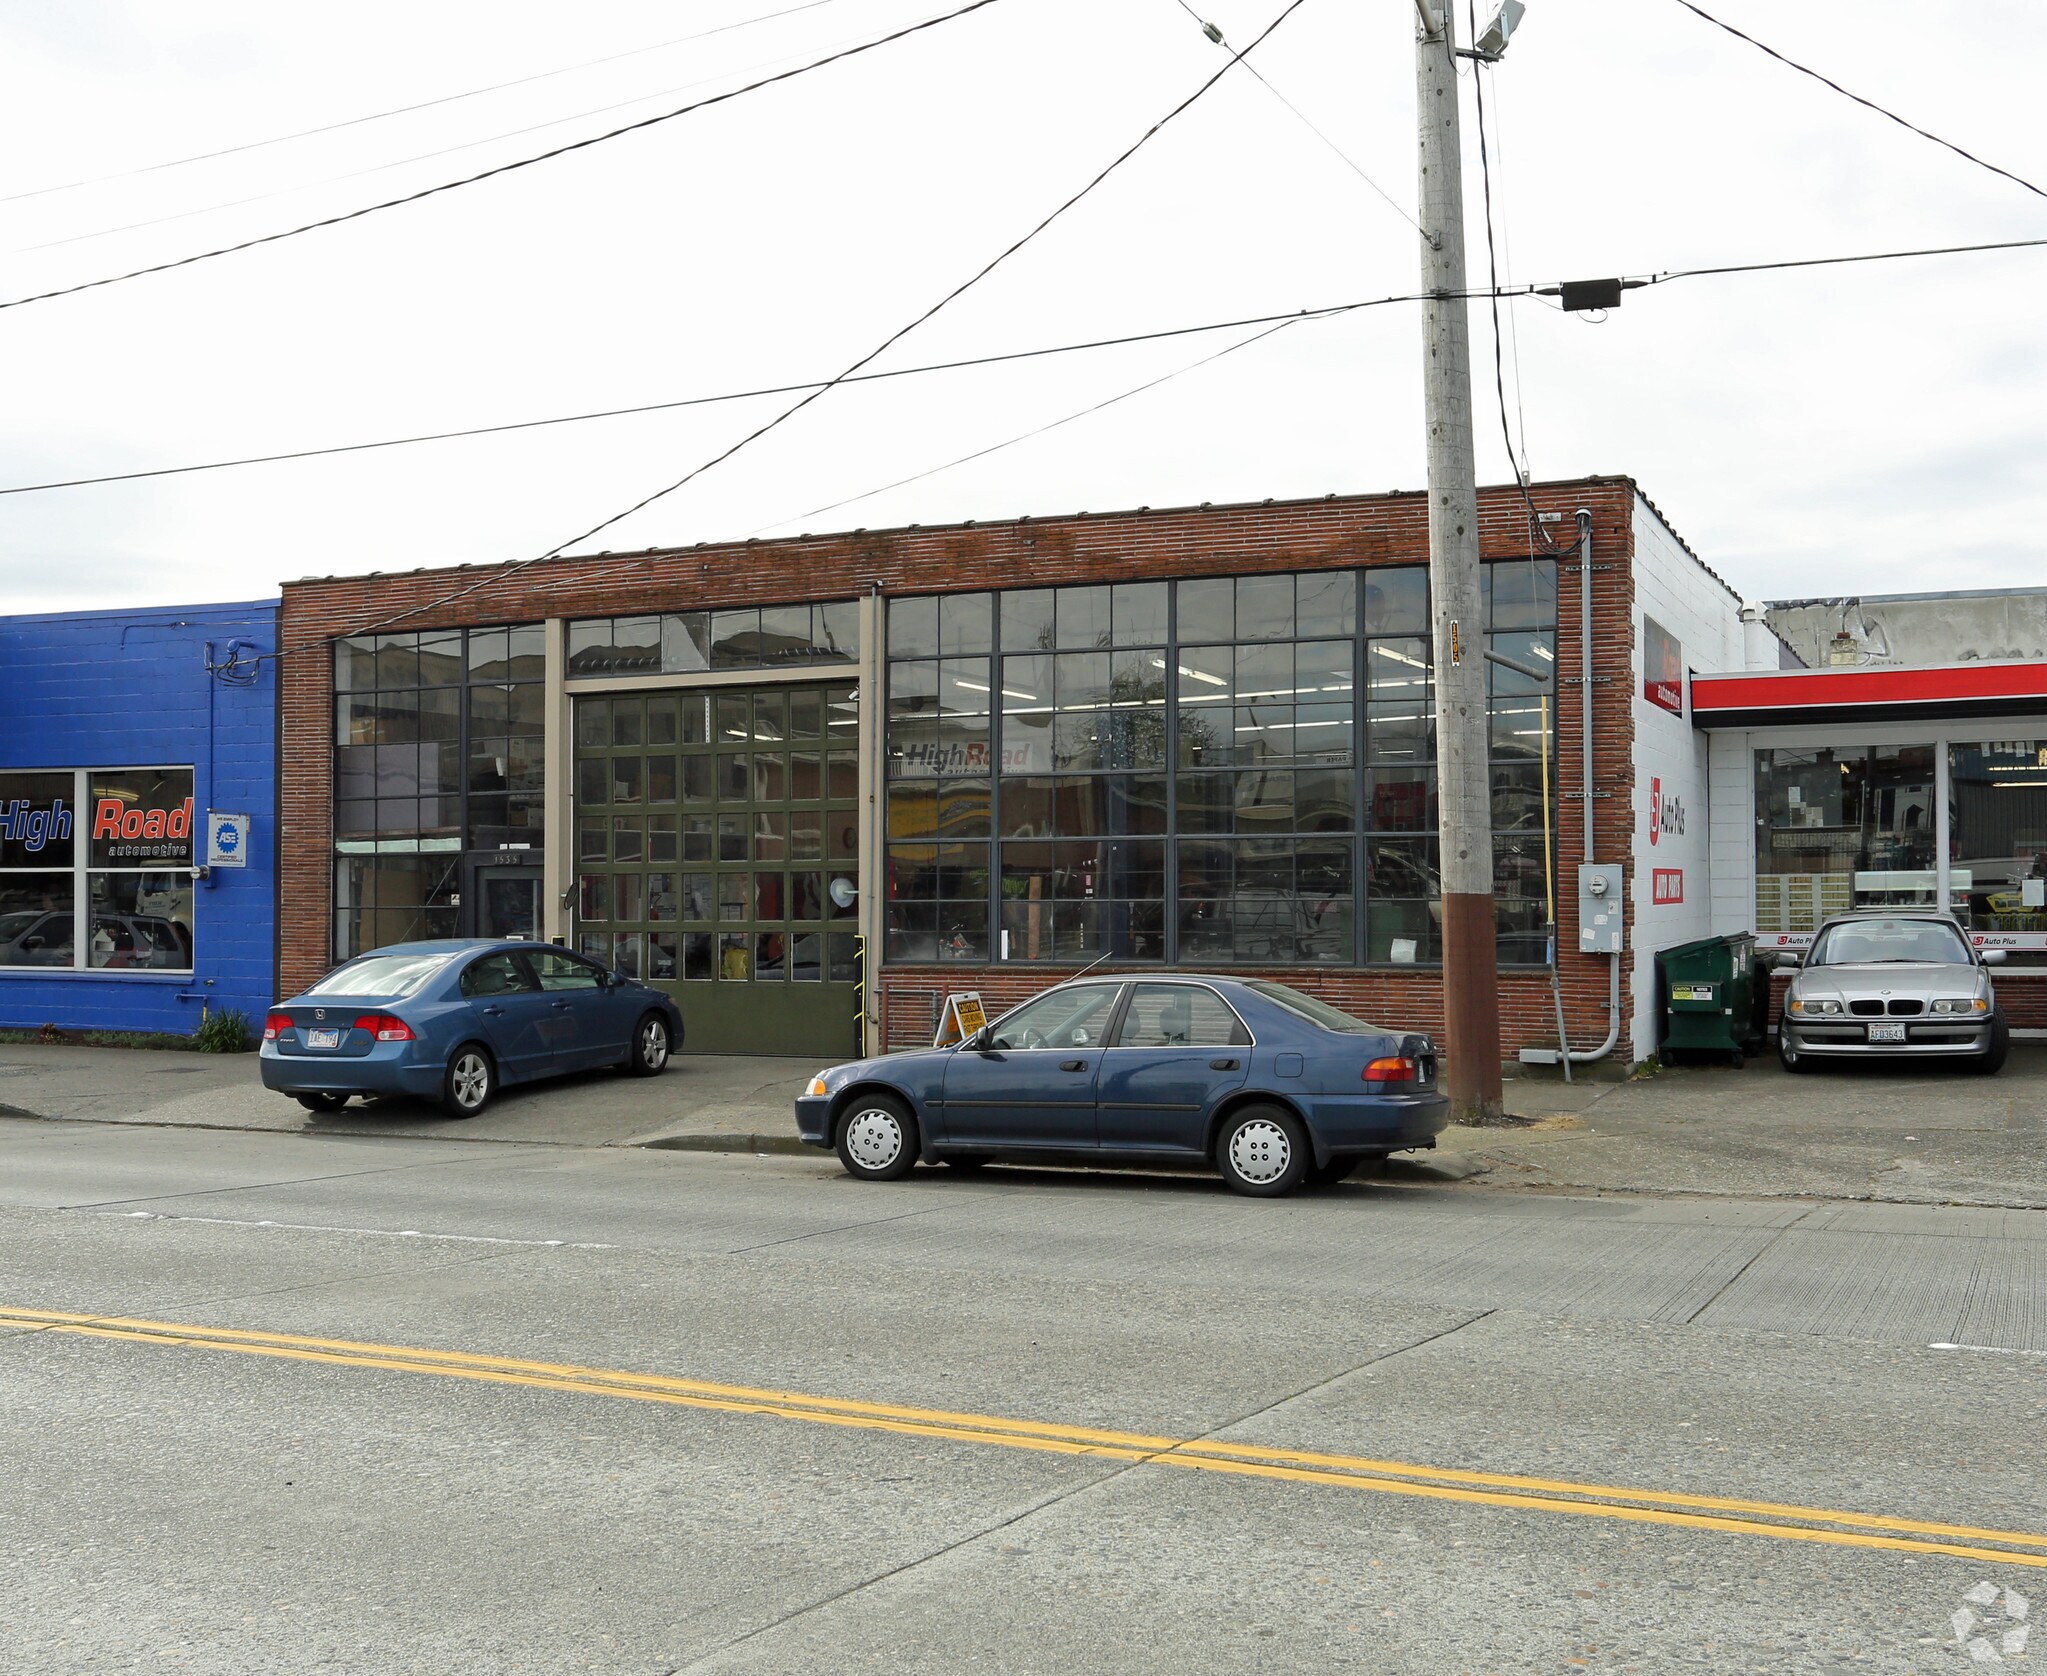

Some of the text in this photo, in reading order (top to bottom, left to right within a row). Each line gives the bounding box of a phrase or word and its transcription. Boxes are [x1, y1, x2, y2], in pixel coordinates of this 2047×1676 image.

[0, 797, 194, 852] High Road
[1660, 794, 1685, 836] Auto Plus
[218, 832, 236, 844] ASE
[108, 843, 188, 857] automotive
[1656, 874, 1668, 899] AUTO
[958, 1001, 980, 1013] CAUTION
